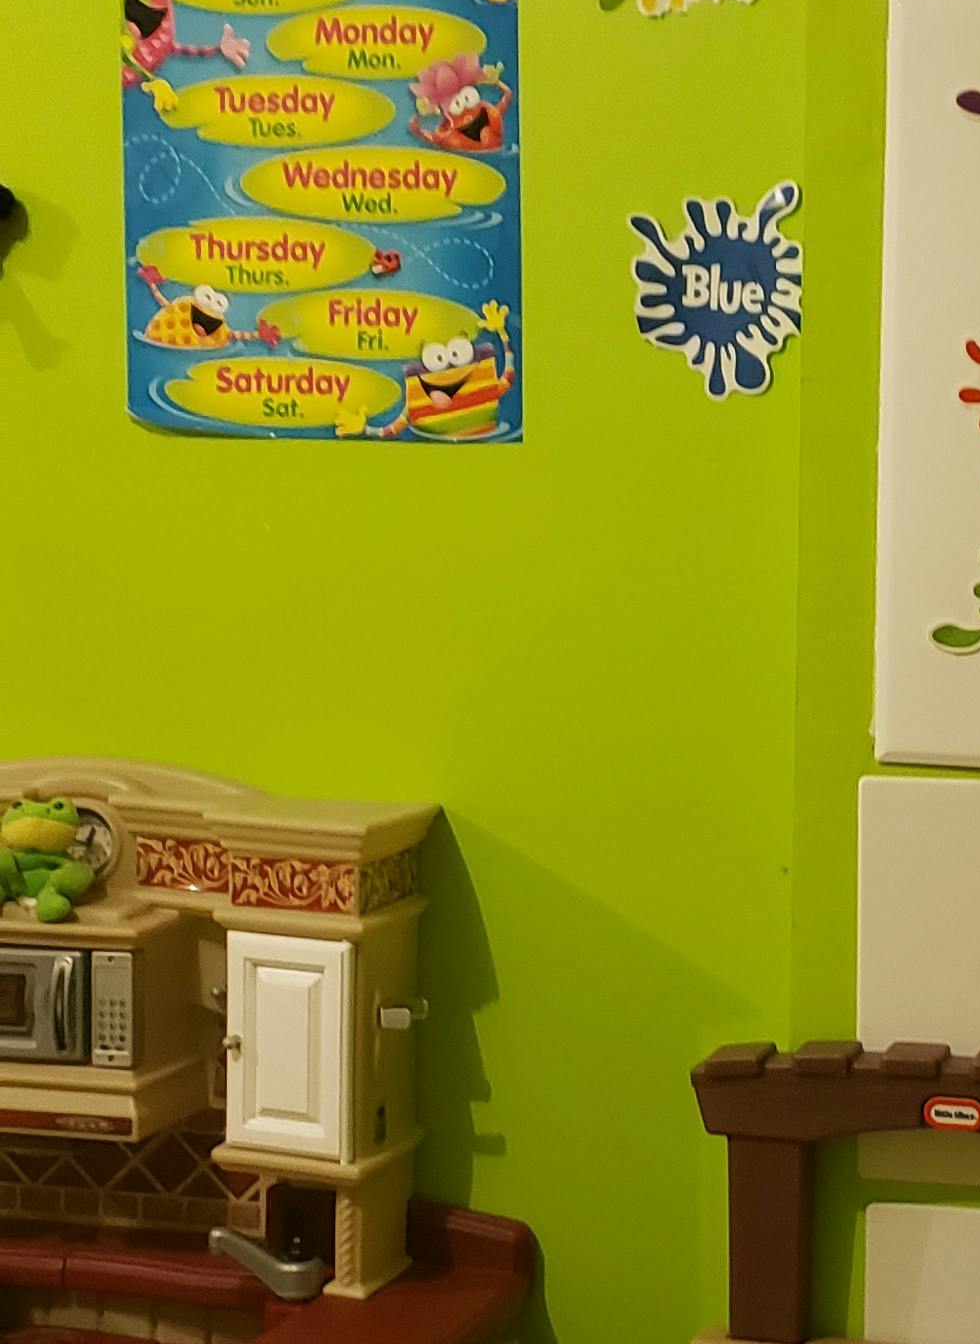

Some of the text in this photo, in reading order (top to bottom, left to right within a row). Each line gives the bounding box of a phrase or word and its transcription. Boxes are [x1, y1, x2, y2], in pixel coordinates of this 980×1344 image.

[314, 15, 434, 53] Monday
[347, 49, 401, 70] Mon.
[213, 85, 335, 122] Tuesday
[248, 117, 302, 138] Tues.
[282, 160, 458, 197] Wednesday
[341, 193, 398, 215] Wed.
[189, 233, 325, 269] Thursday
[226, 265, 290, 287] Thurs.
[681, 262, 765, 314] Blue
[328, 298, 418, 335] Friday
[356, 330, 390, 353] Fri.
[216, 367, 351, 401] Saturday
[261, 397, 304, 419] Sat.
